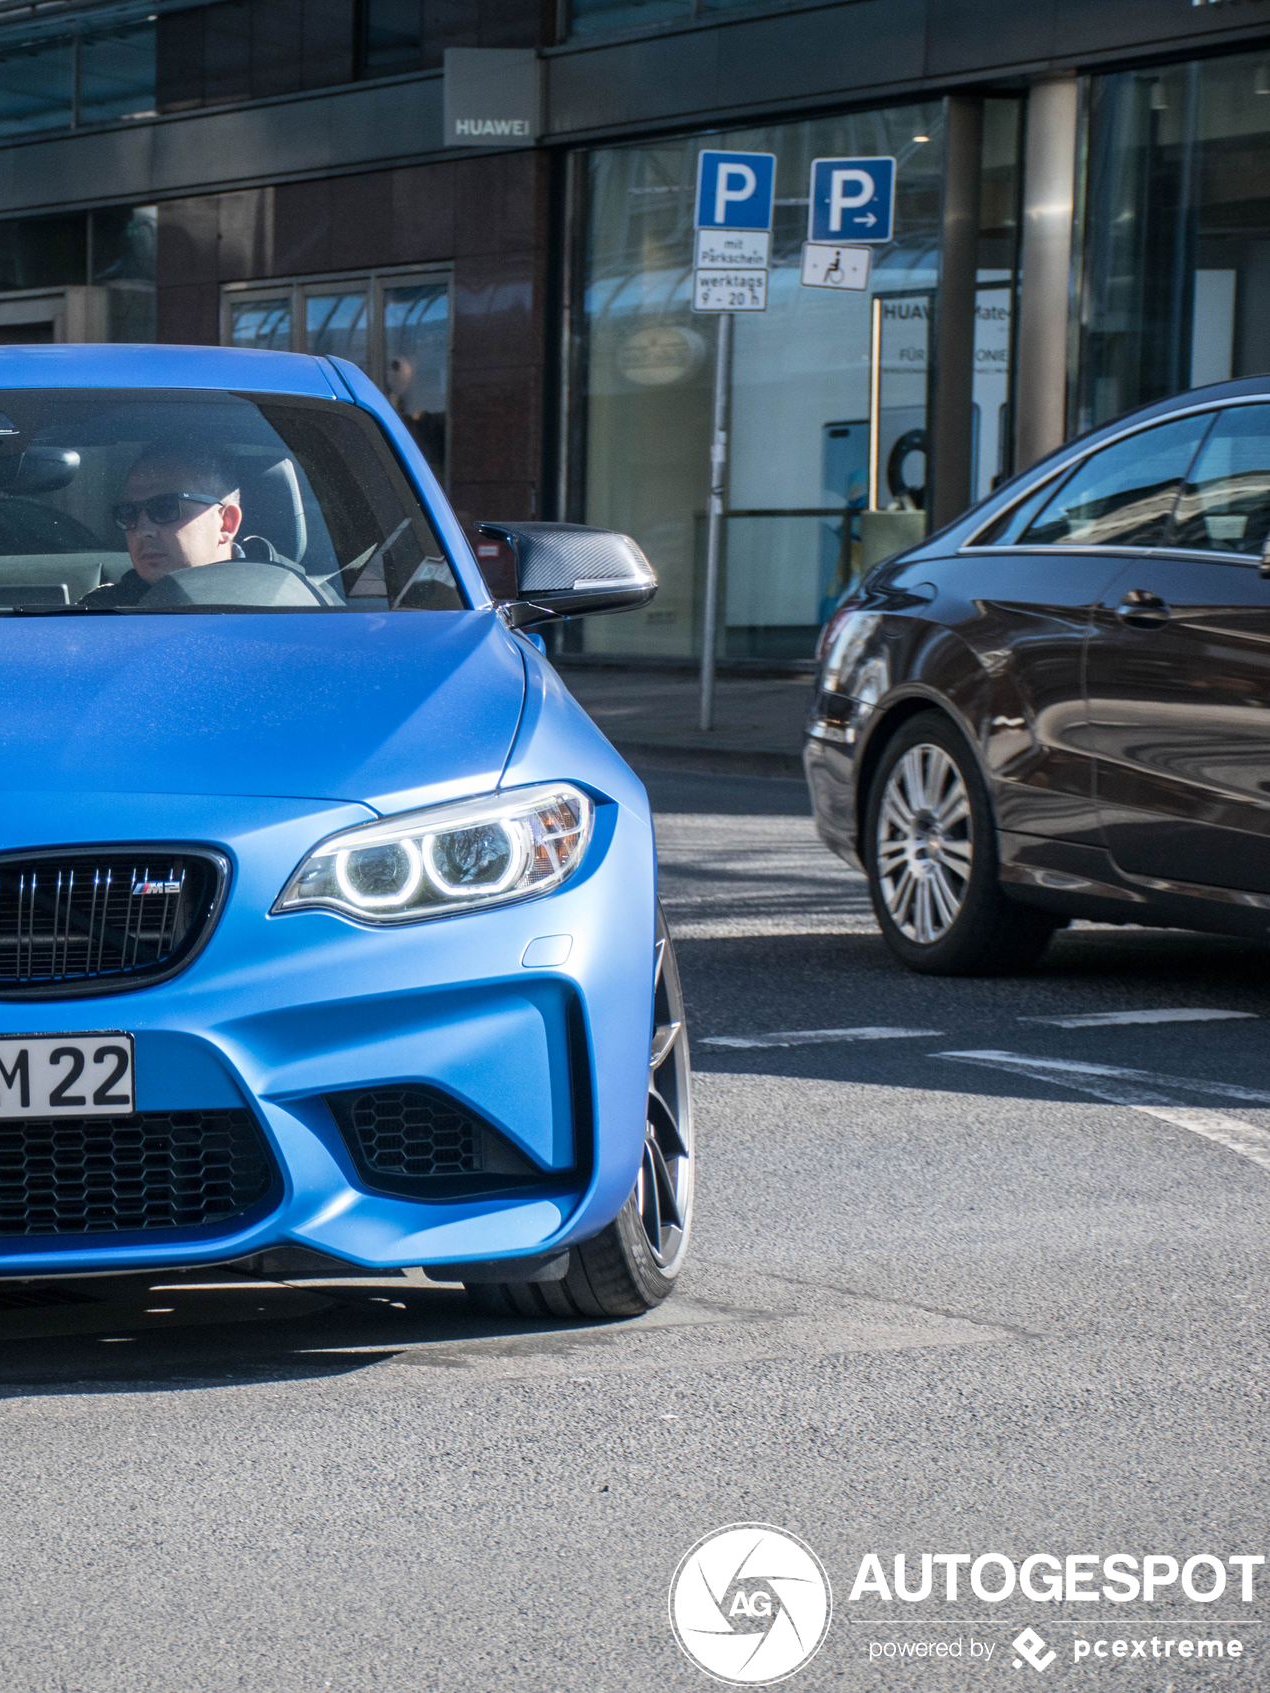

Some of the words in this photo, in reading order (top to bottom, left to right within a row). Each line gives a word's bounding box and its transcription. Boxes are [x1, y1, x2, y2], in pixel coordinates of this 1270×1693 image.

[455, 119, 530, 136] HUAWEI
[714, 162, 757, 225] P
[829, 169, 875, 232] P
[724, 239, 744, 250] mit
[701, 251, 765, 265] Parkschein
[699, 275, 764, 290] werktags
[701, 292, 710, 305] 9
[729, 292, 745, 306] 20
[751, 292, 760, 306] h
[146, 881, 180, 895] M2
[48, 1046, 130, 1107] 22
